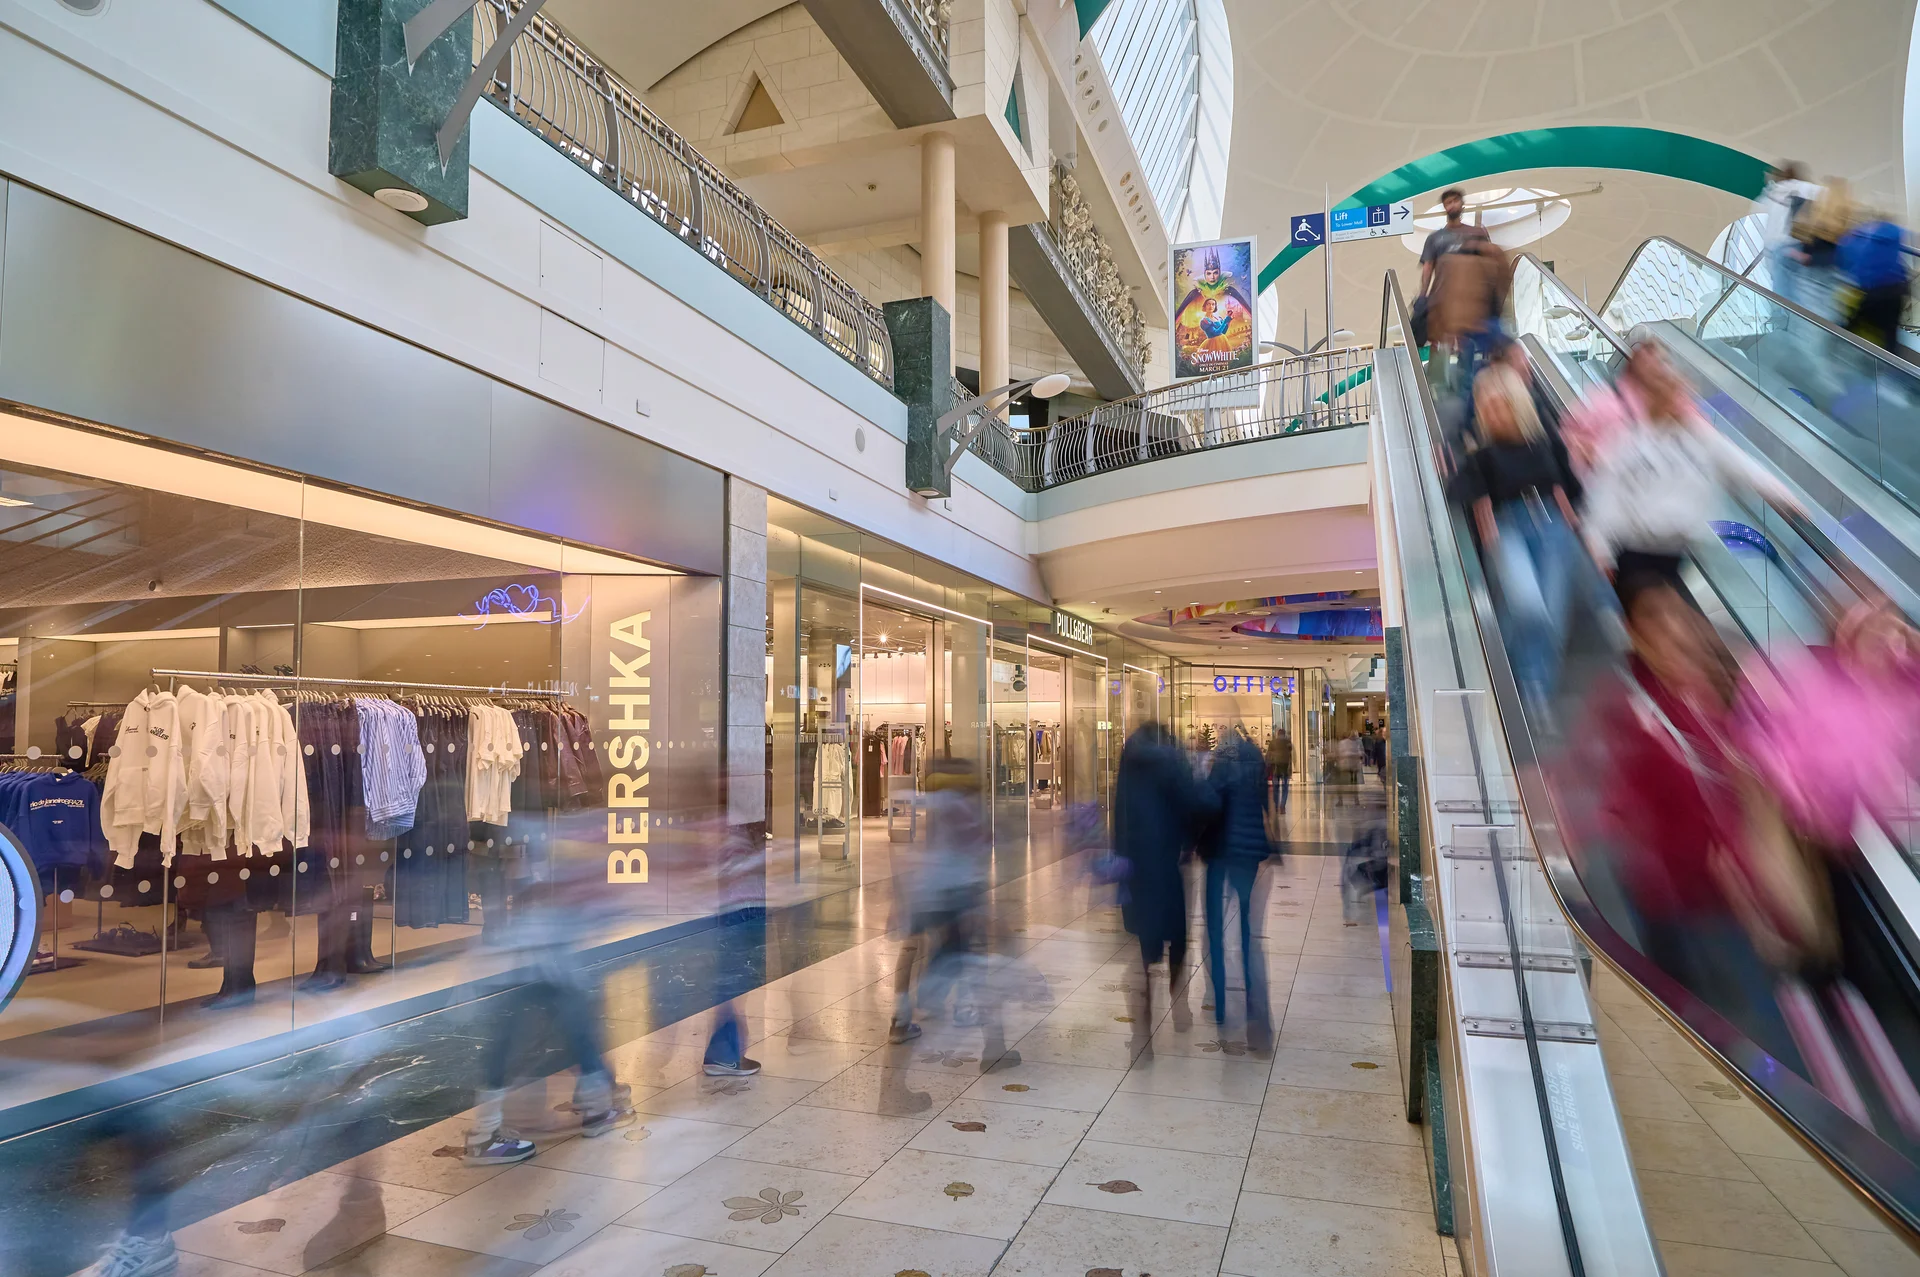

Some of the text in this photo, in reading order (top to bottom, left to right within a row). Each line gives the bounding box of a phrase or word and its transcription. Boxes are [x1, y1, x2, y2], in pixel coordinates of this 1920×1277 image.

[1335, 212, 1348, 221] Lift
[1056, 612, 1093, 646] PULL&BEAR
[1213, 675, 1296, 694] OFFICE
[607, 611, 651, 884] BERSHKA
[1546, 1070, 1568, 1131] KEEP OFF
[1557, 1062, 1584, 1152] SIDE BRUSHES
